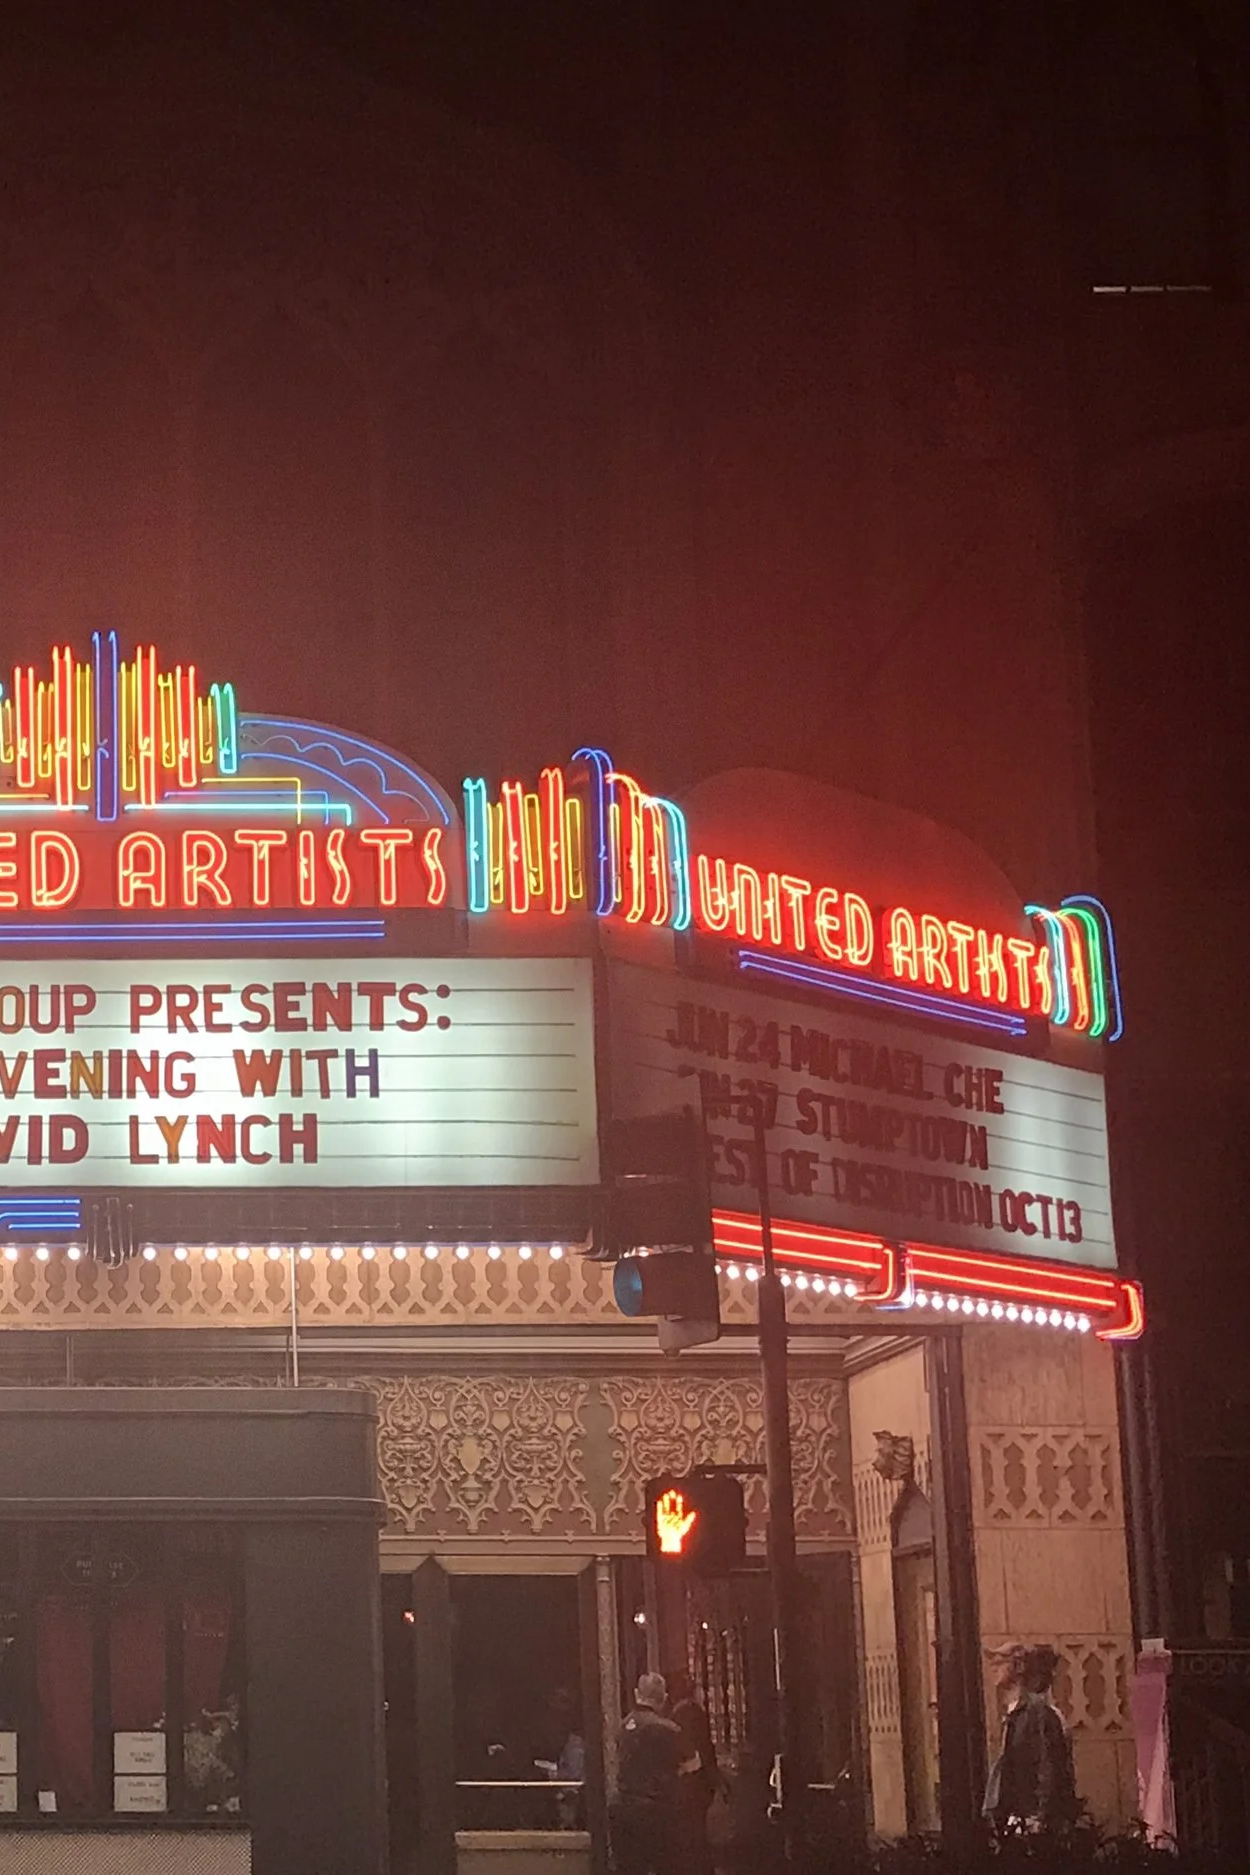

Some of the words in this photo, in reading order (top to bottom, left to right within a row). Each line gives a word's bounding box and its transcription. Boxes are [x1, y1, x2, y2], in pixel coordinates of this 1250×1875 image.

[117, 827, 447, 908] ARTISTS
[697, 854, 874, 967] UNITED
[888, 906, 1052, 1015] ARTISTS
[129, 980, 452, 1035] PRESENTS:
[232, 1047, 380, 1100] WITH
[734, 1014, 781, 1070] 24
[790, 1024, 934, 1101] MICHAEL
[943, 1061, 1005, 1115] CHE
[128, 1112, 319, 1165] LYNCH
[795, 1086, 990, 1171] STUMPTOWN
[779, 1147, 820, 1198] OF
[831, 1154, 994, 1232] DISRUPTION
